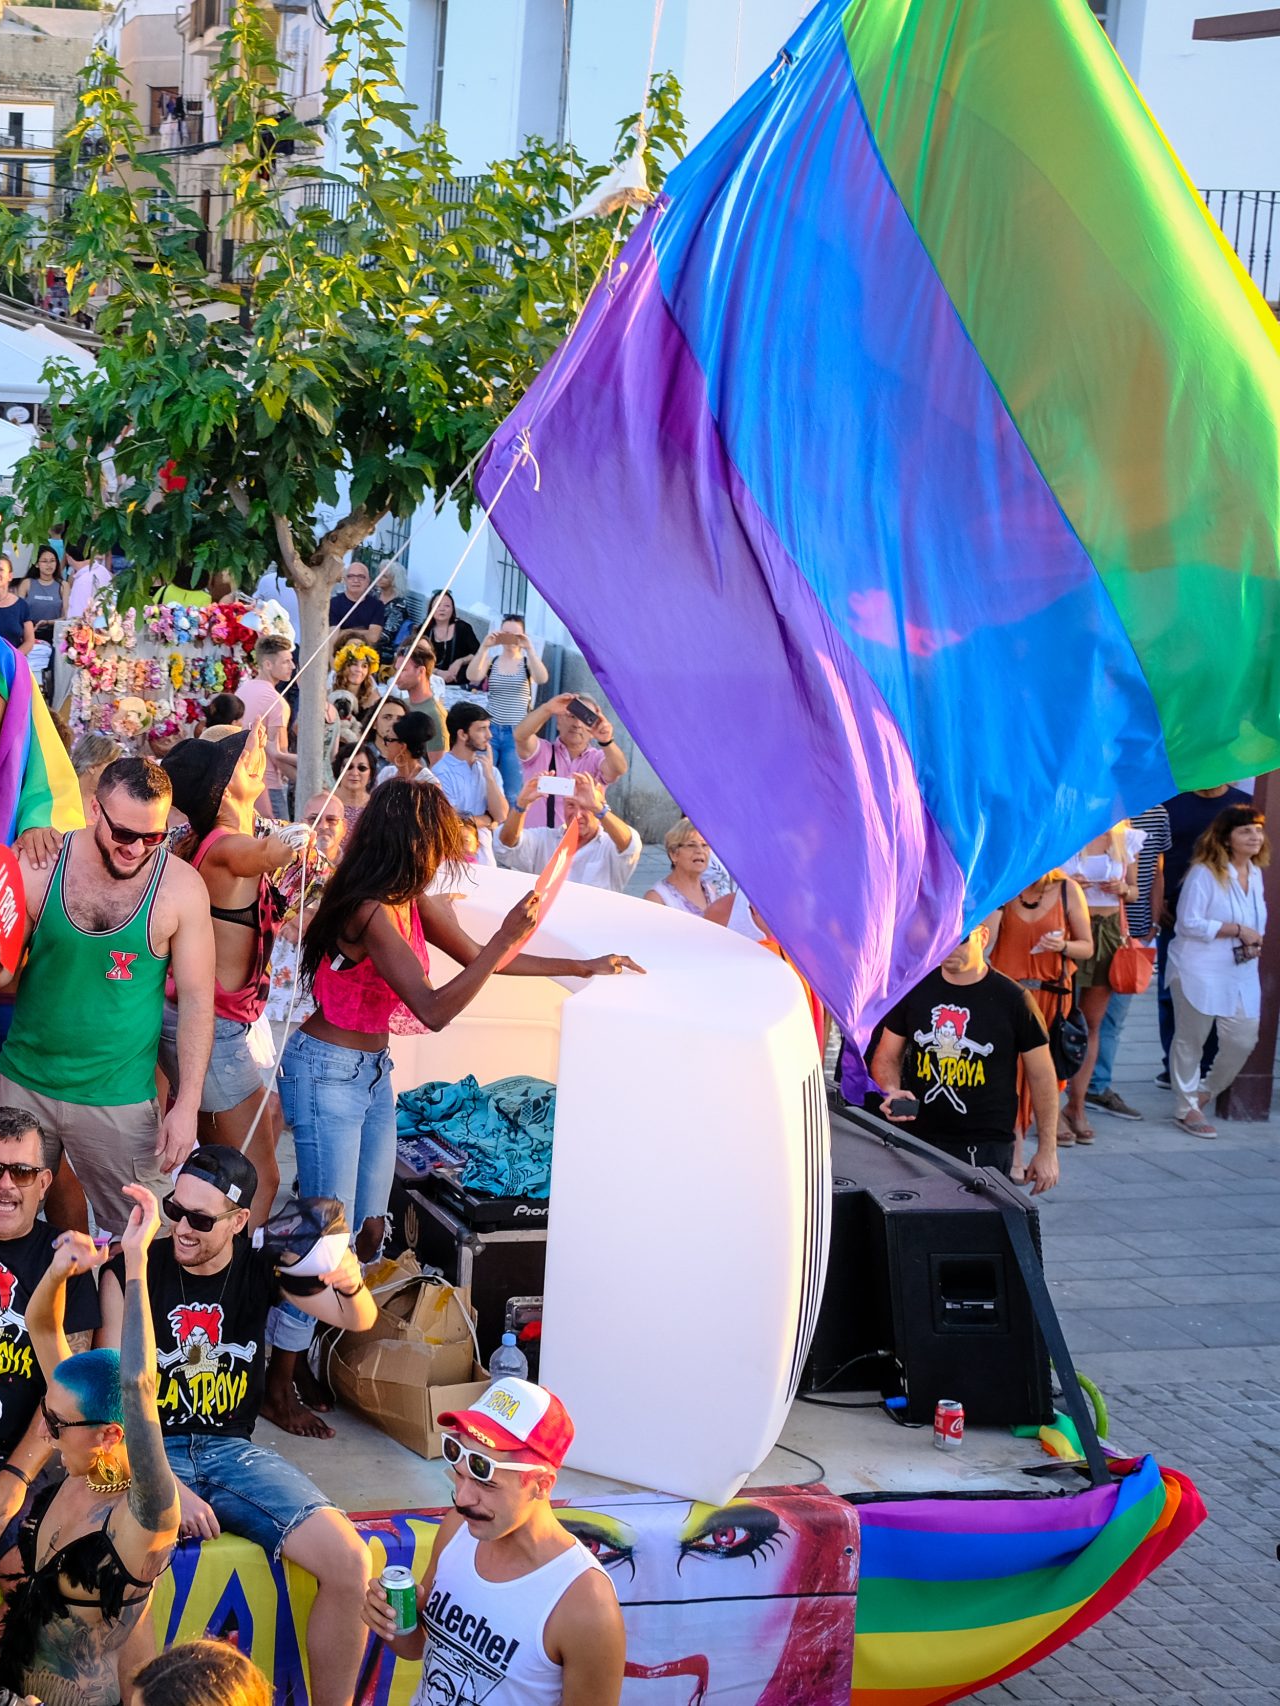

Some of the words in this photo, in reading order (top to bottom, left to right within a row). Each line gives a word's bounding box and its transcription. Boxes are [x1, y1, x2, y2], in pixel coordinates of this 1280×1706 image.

[106, 951, 139, 980] X
[917, 1052, 932, 1082] LA
[939, 1057, 986, 1088] TROYA
[156, 1372, 180, 1410] LA
[423, 1580, 520, 1672] aLeche!
